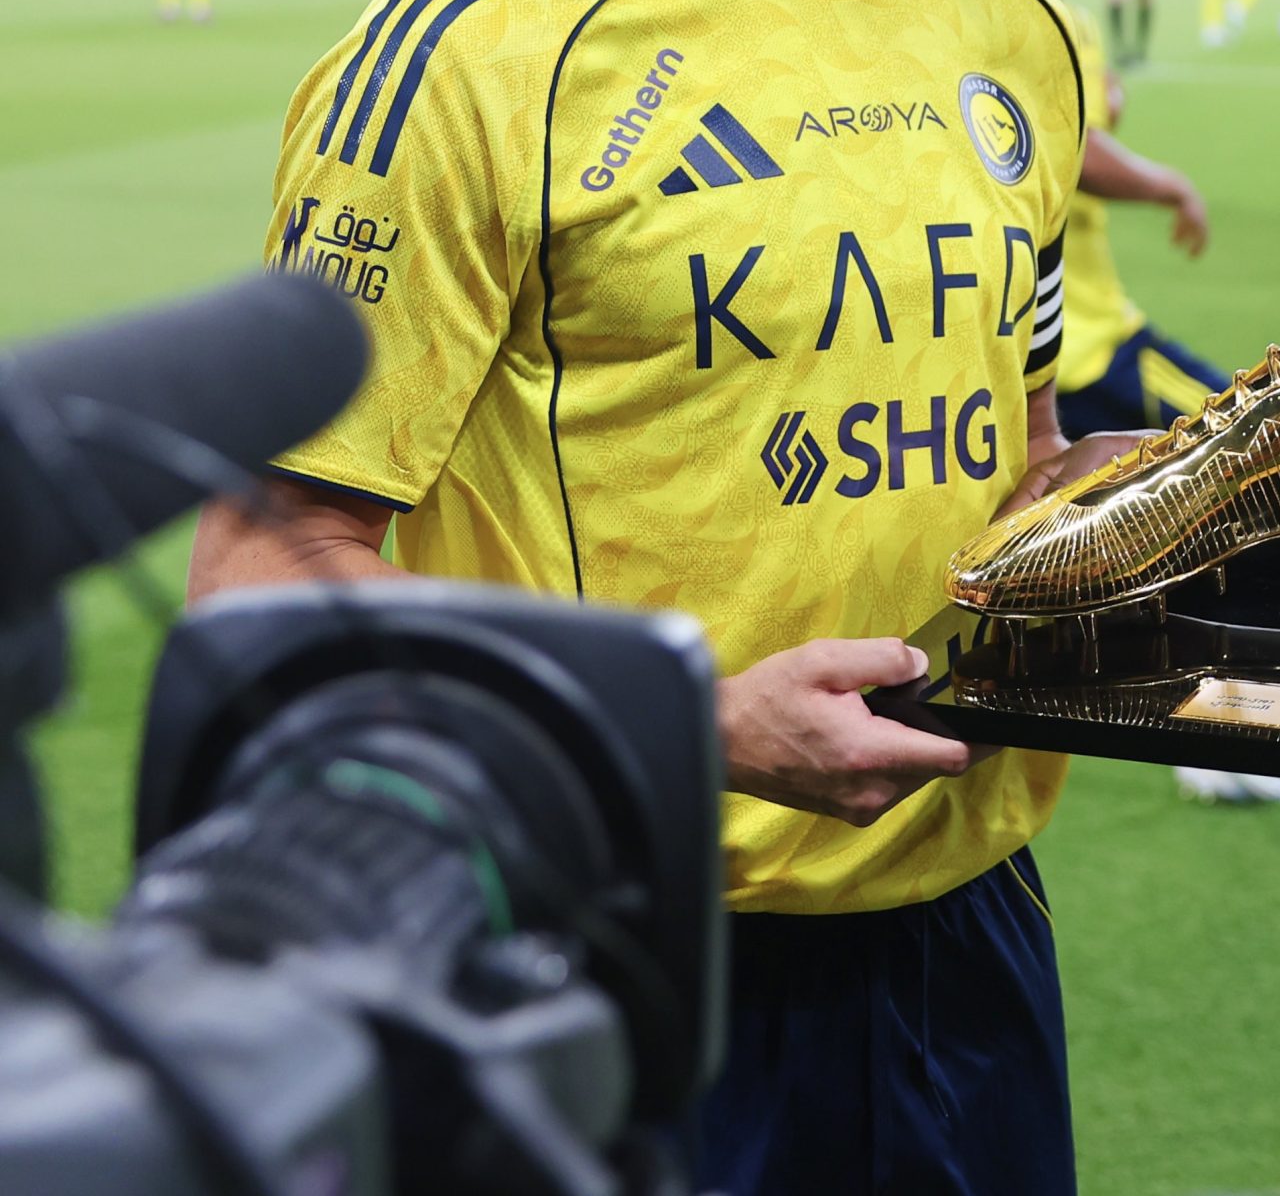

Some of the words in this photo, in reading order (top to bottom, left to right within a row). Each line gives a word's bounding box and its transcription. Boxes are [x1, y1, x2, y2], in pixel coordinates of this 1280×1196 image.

[580, 47, 685, 192] Gathern
[314, 205, 400, 252] نوق
[688, 223, 1038, 369] KAFD
[834, 388, 997, 498] SHG
